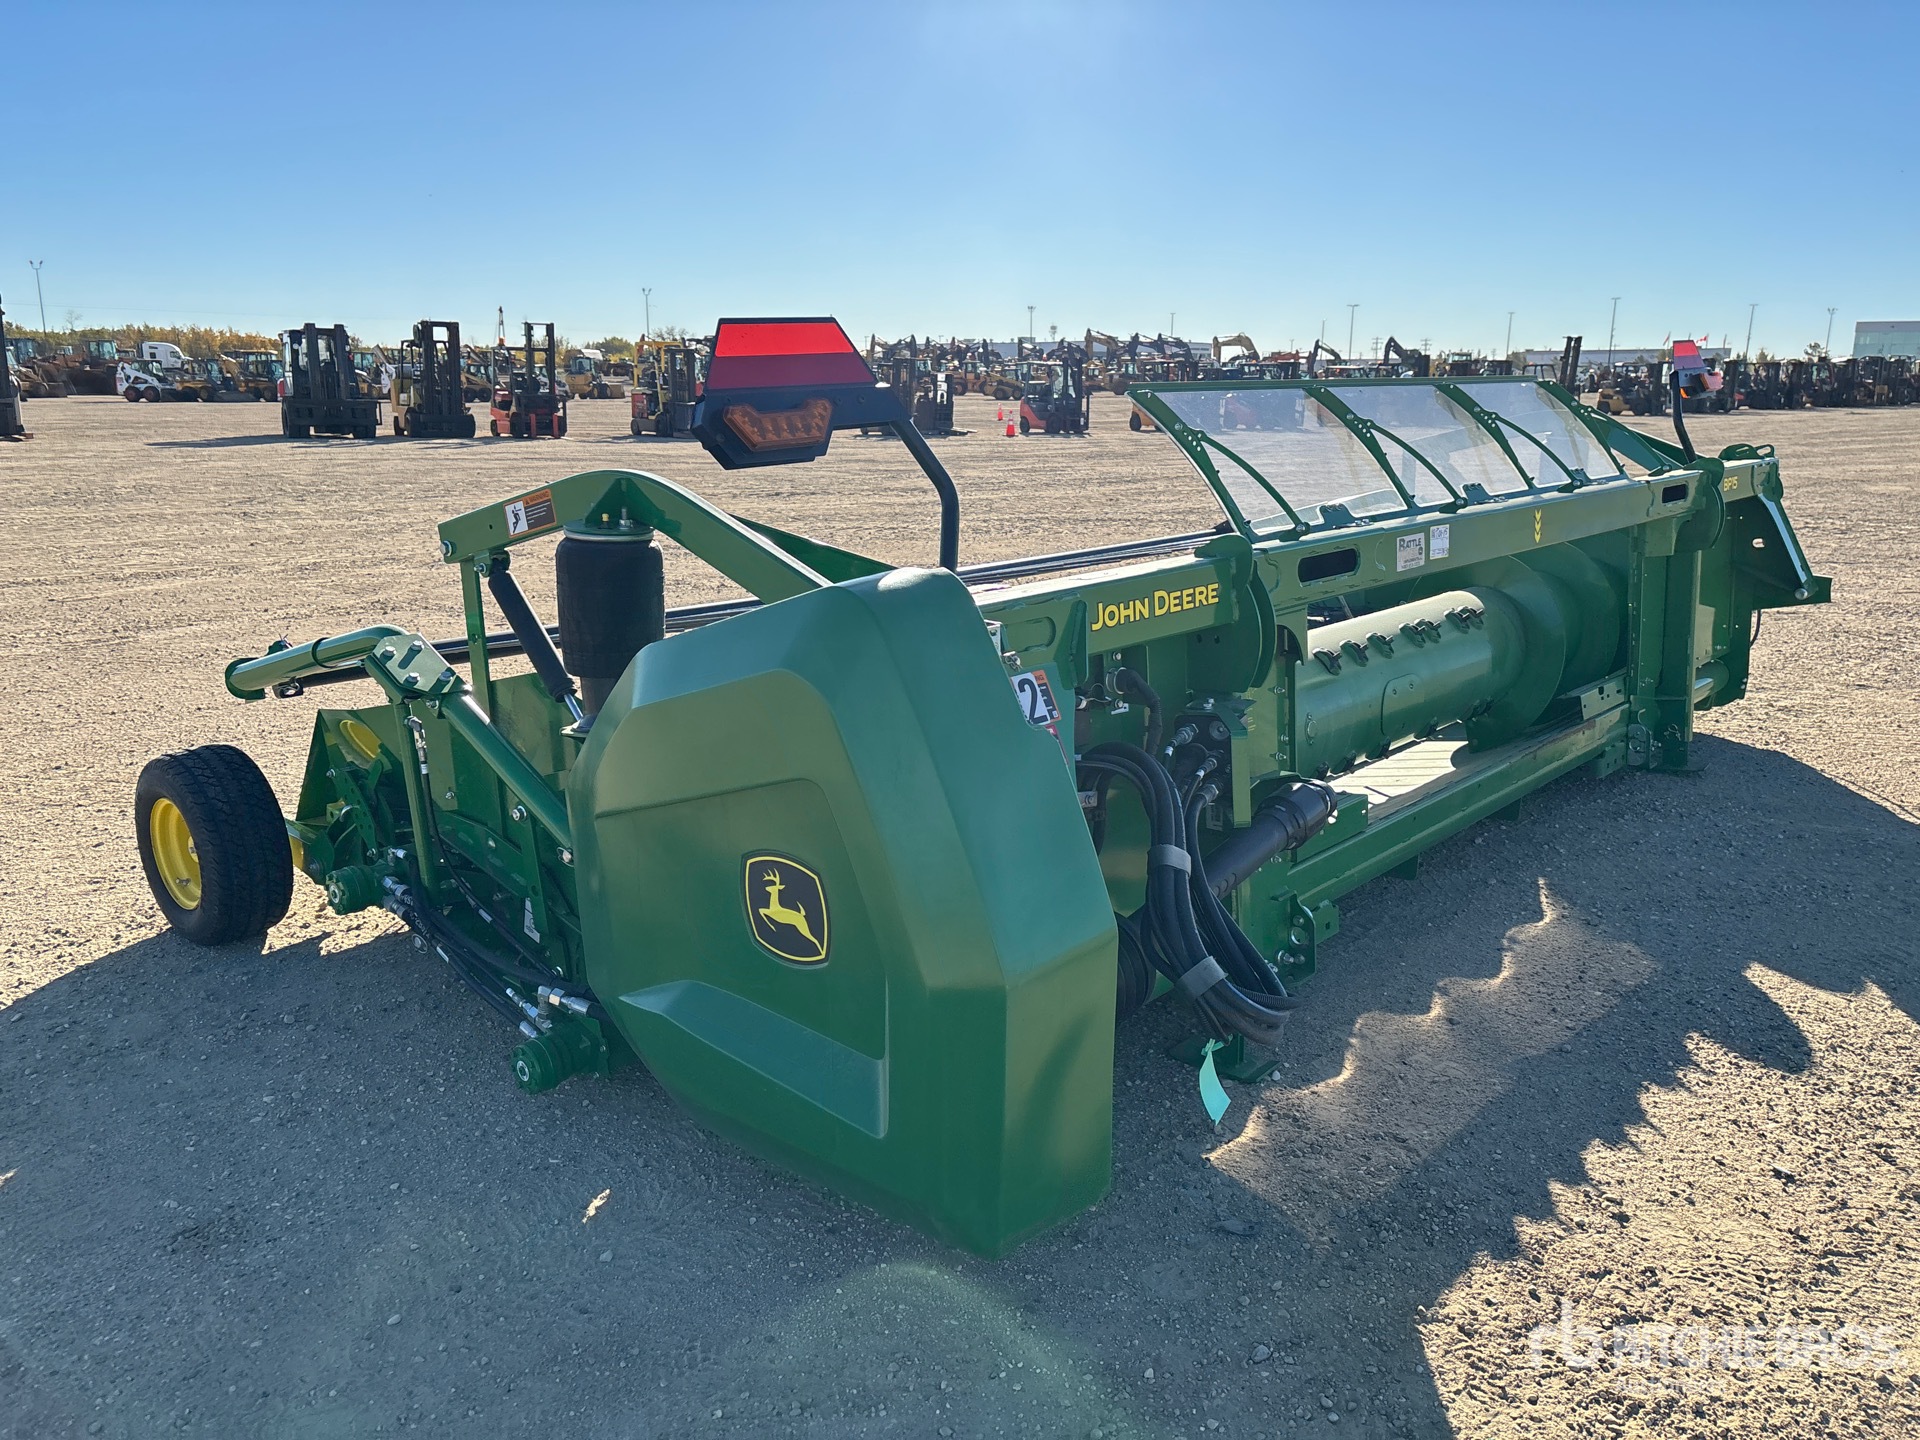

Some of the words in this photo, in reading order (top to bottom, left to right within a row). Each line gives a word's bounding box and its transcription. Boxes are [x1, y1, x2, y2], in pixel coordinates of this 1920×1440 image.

[1399, 537, 1422, 552] RATTLE
[1091, 597, 1150, 631] JOHN
[1153, 582, 1219, 617] DEERE
